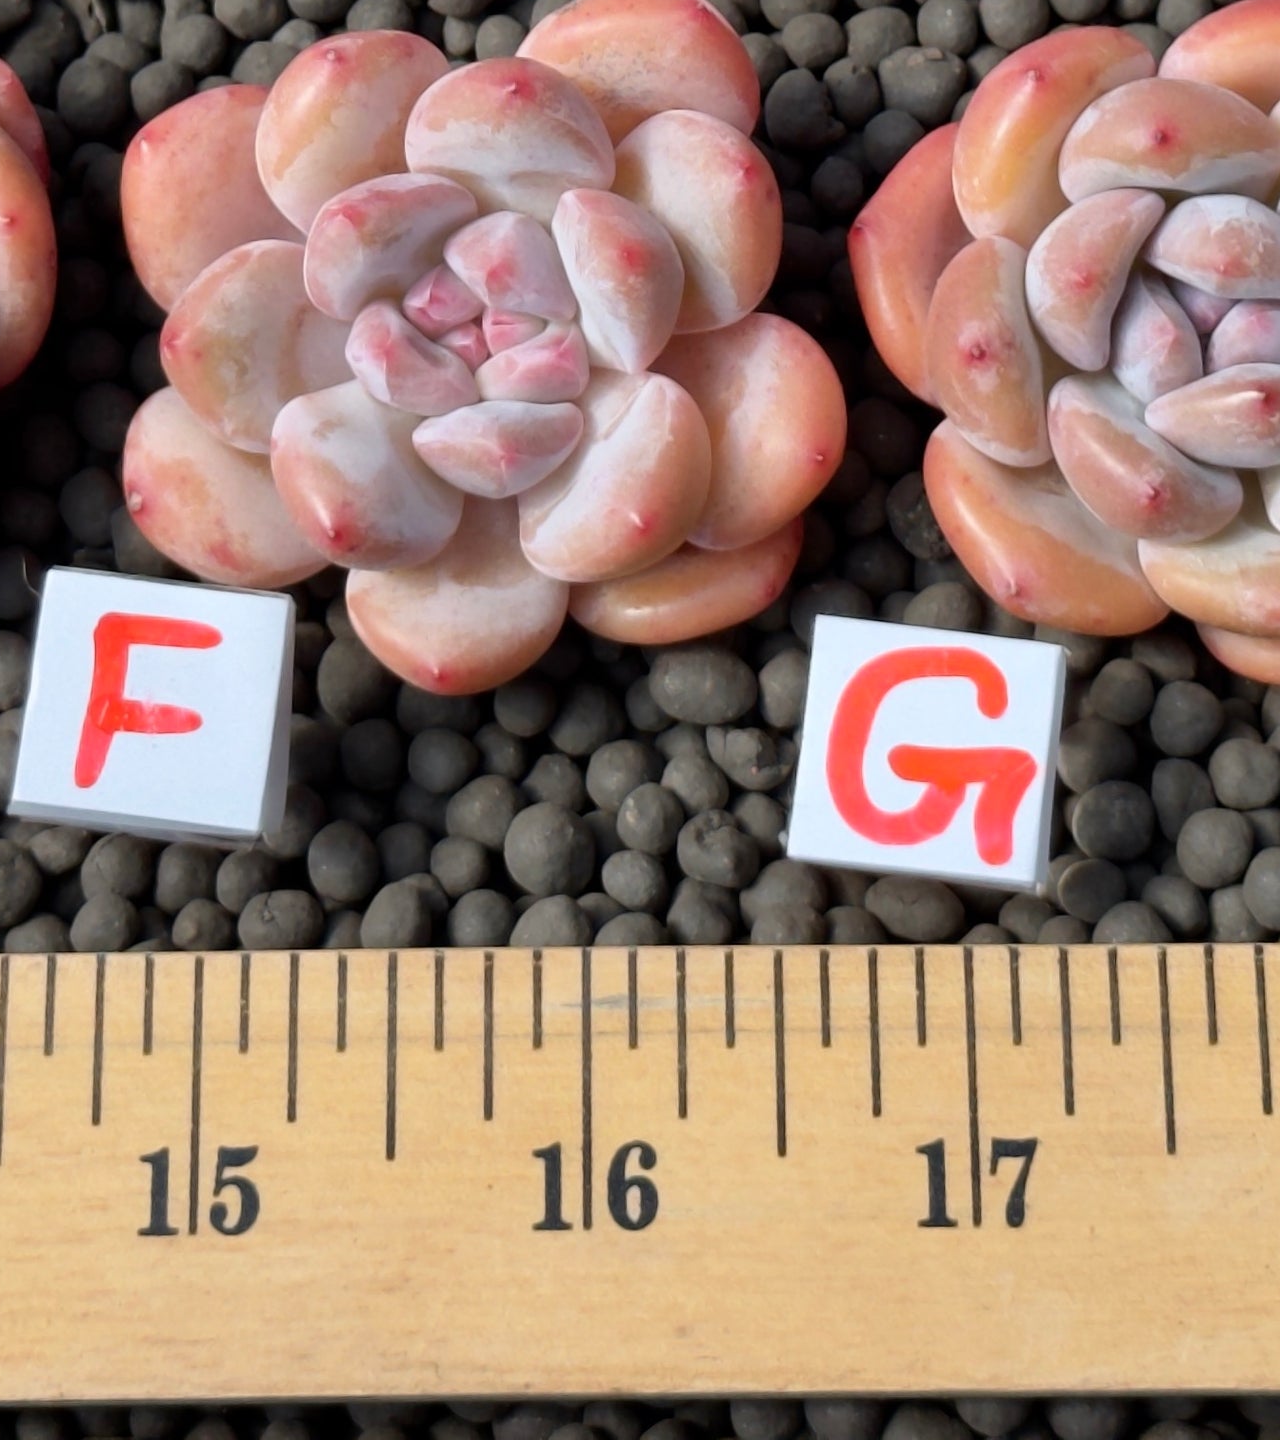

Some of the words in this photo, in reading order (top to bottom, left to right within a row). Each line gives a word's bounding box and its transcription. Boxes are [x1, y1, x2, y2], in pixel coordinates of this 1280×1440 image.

[75, 613, 220, 787] F
[828, 649, 1036, 864] G
[139, 1145, 259, 1236] 15
[534, 1140, 658, 1231] 16
[917, 1138, 1035, 1228] 17
